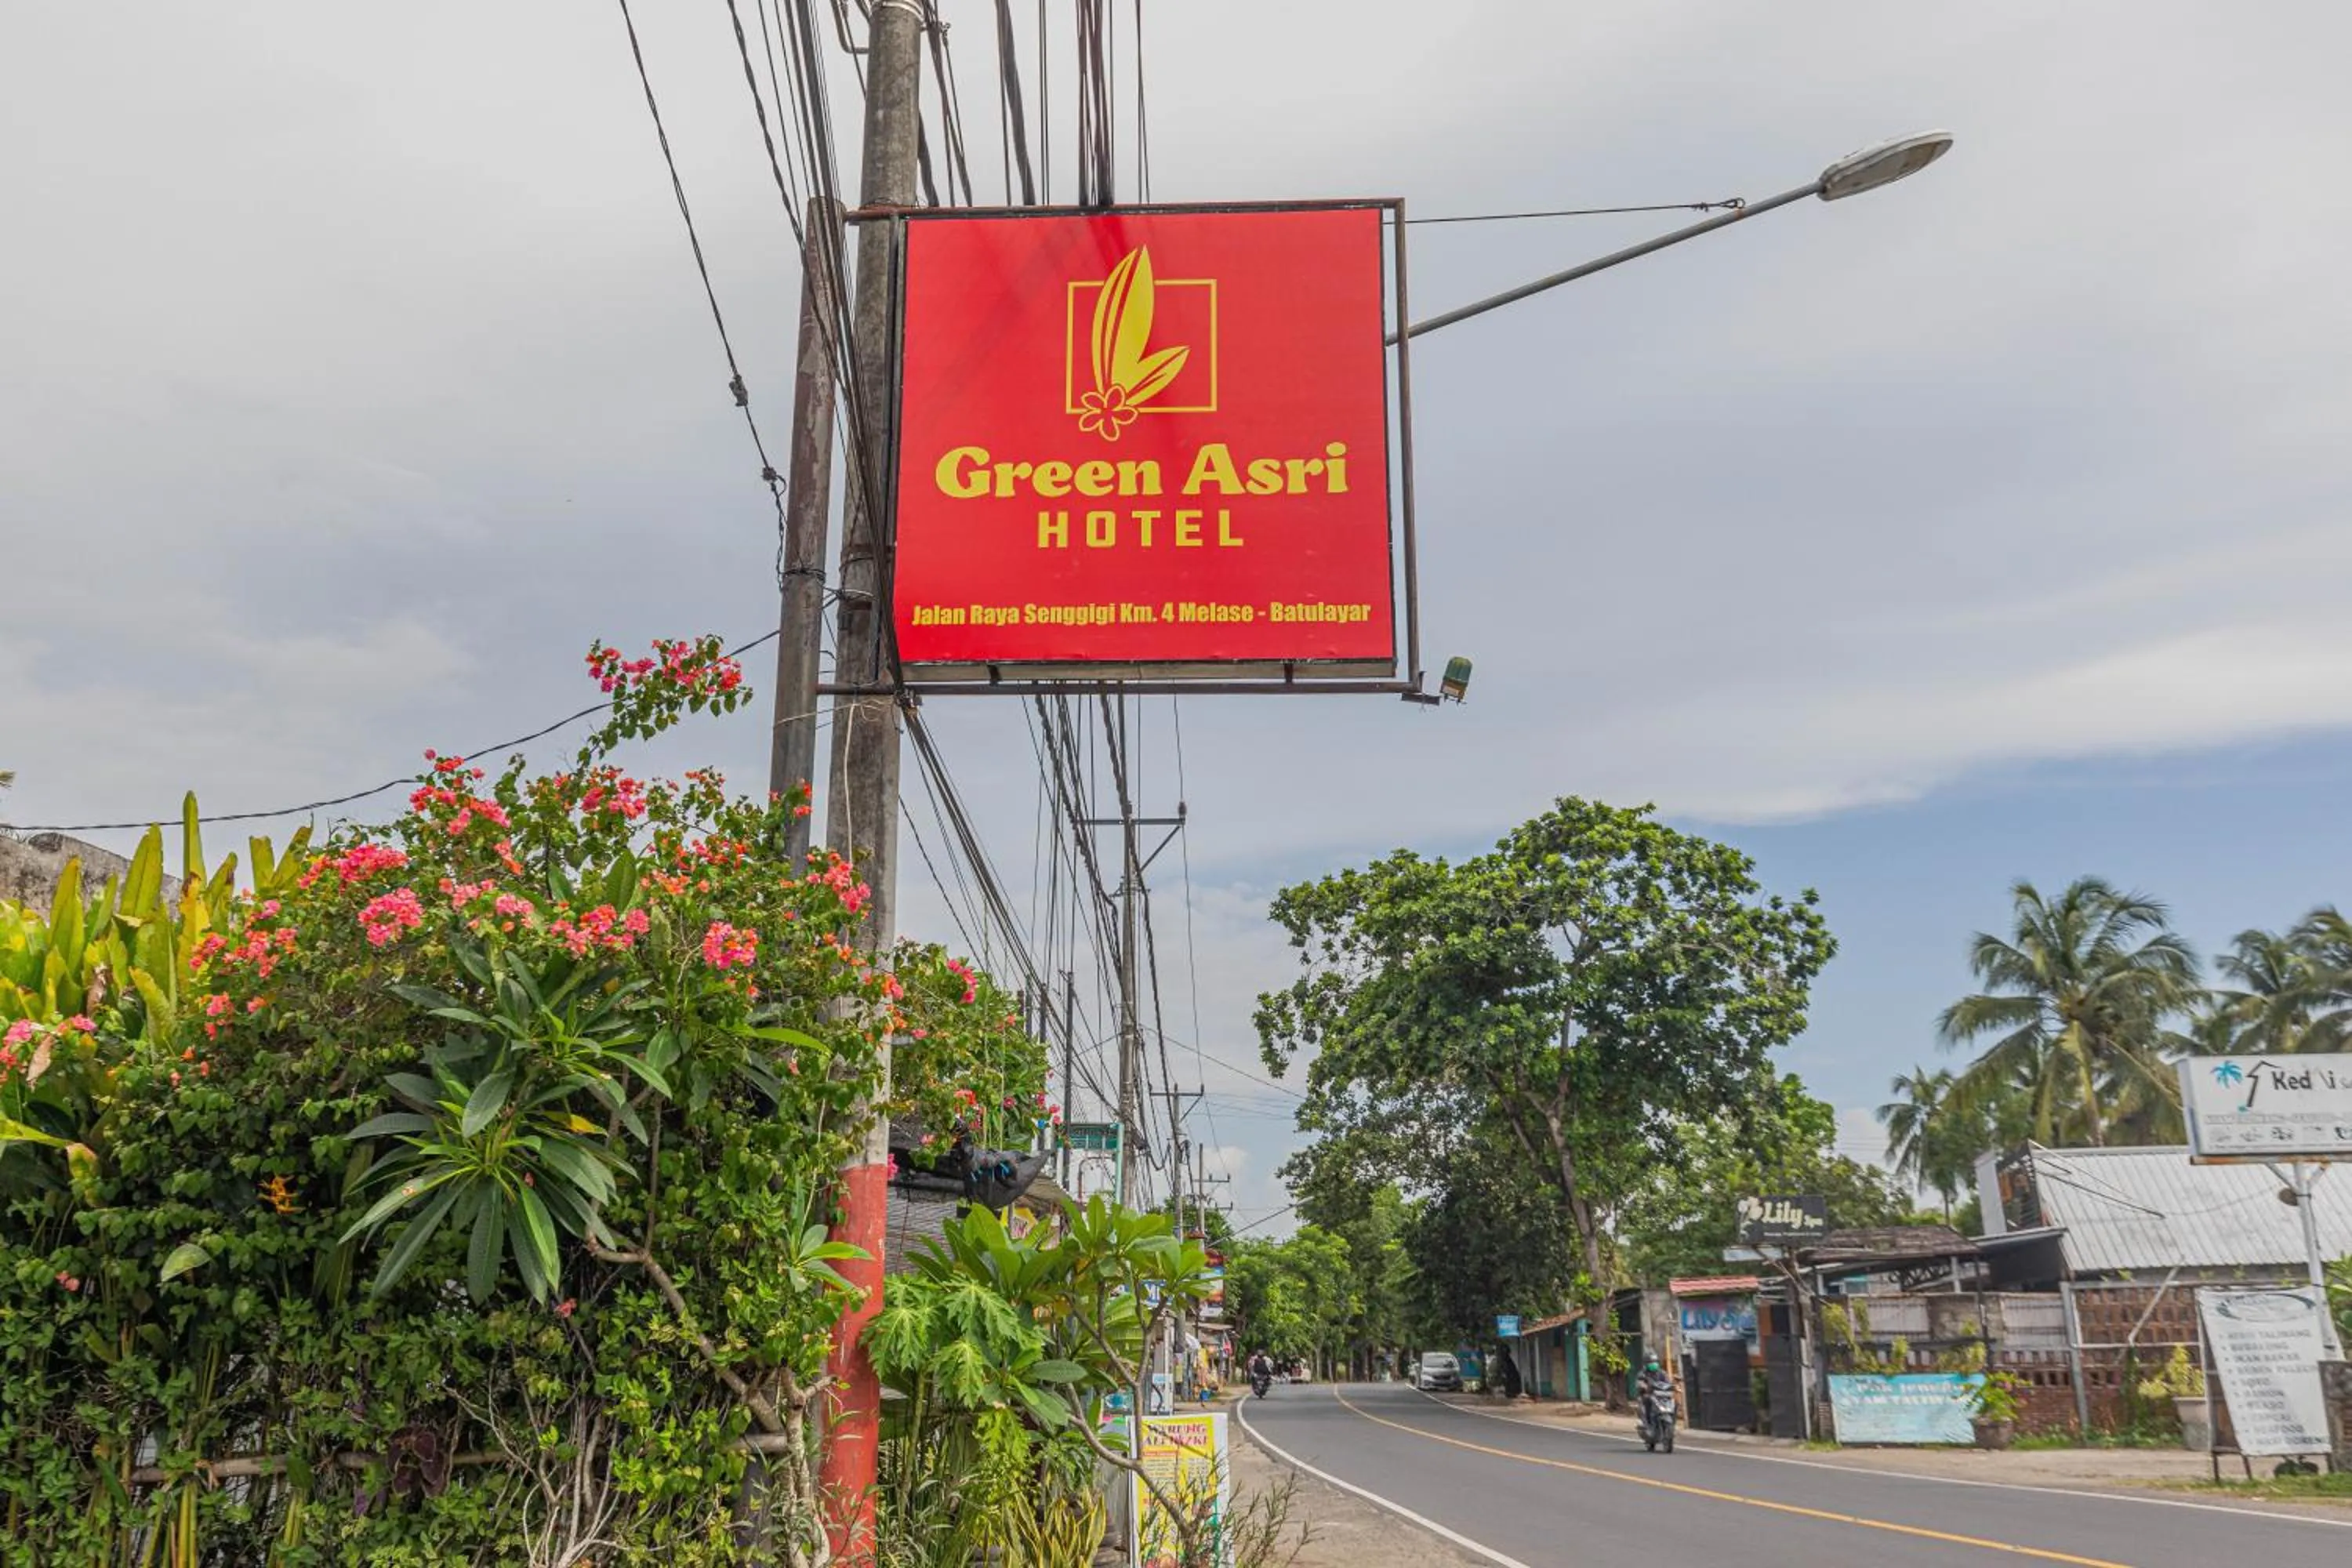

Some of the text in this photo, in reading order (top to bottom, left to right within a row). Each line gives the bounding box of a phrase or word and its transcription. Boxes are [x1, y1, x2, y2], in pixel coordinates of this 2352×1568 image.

[935, 441, 1348, 499] Green Asri
[1037, 510, 1243, 548] HOTEL
[912, 604, 965, 625] Jalan
[970, 604, 1019, 626] Raya
[1025, 603, 1116, 626] Senggigi
[1120, 603, 1157, 623] Km.
[1161, 602, 1174, 622] 4
[1178, 602, 1254, 622] Melase
[1270, 601, 1371, 623] Batulayar
[1761, 1200, 1803, 1229] Lily
